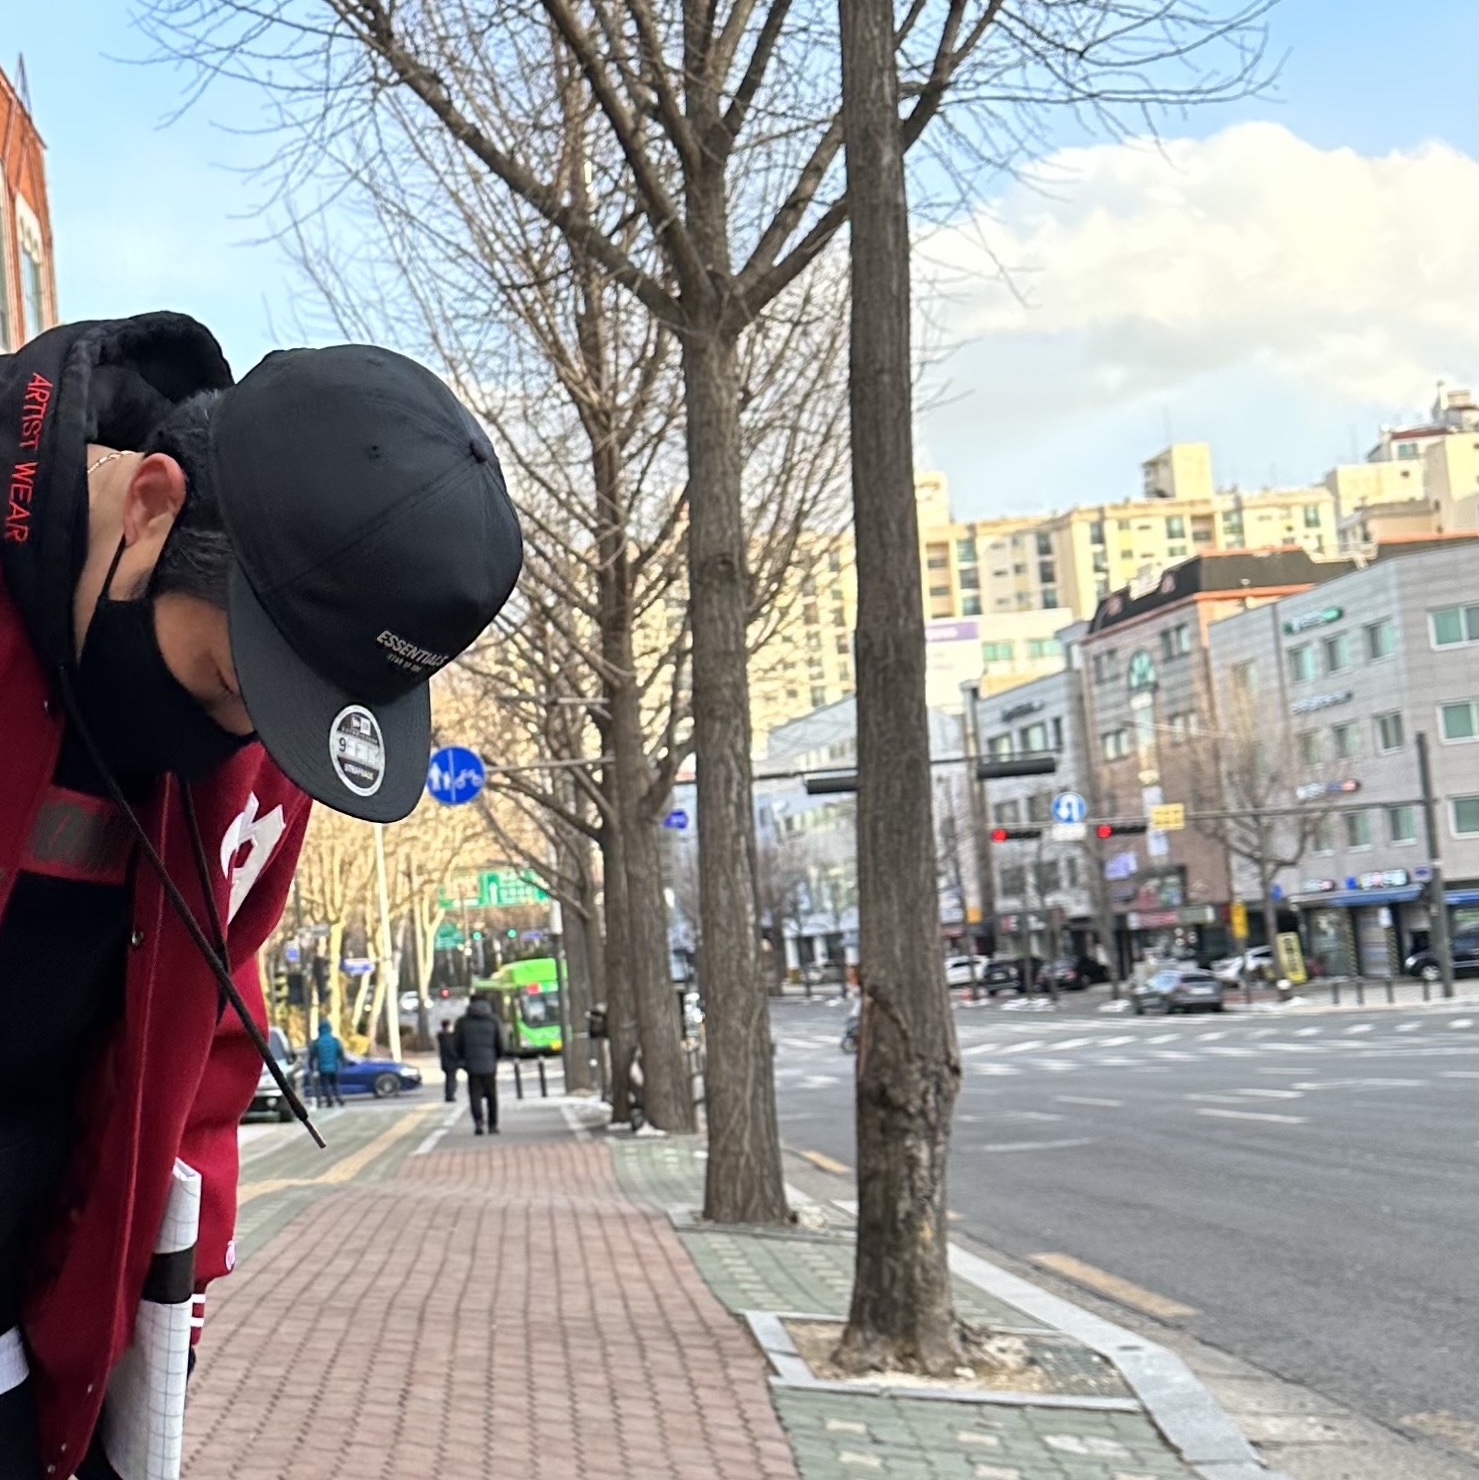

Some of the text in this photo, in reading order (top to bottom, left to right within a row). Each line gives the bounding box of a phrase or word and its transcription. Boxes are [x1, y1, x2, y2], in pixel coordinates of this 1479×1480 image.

[5, 372, 54, 543] ARTIST WEAR
[376, 630, 448, 666] ESSENTIALS
